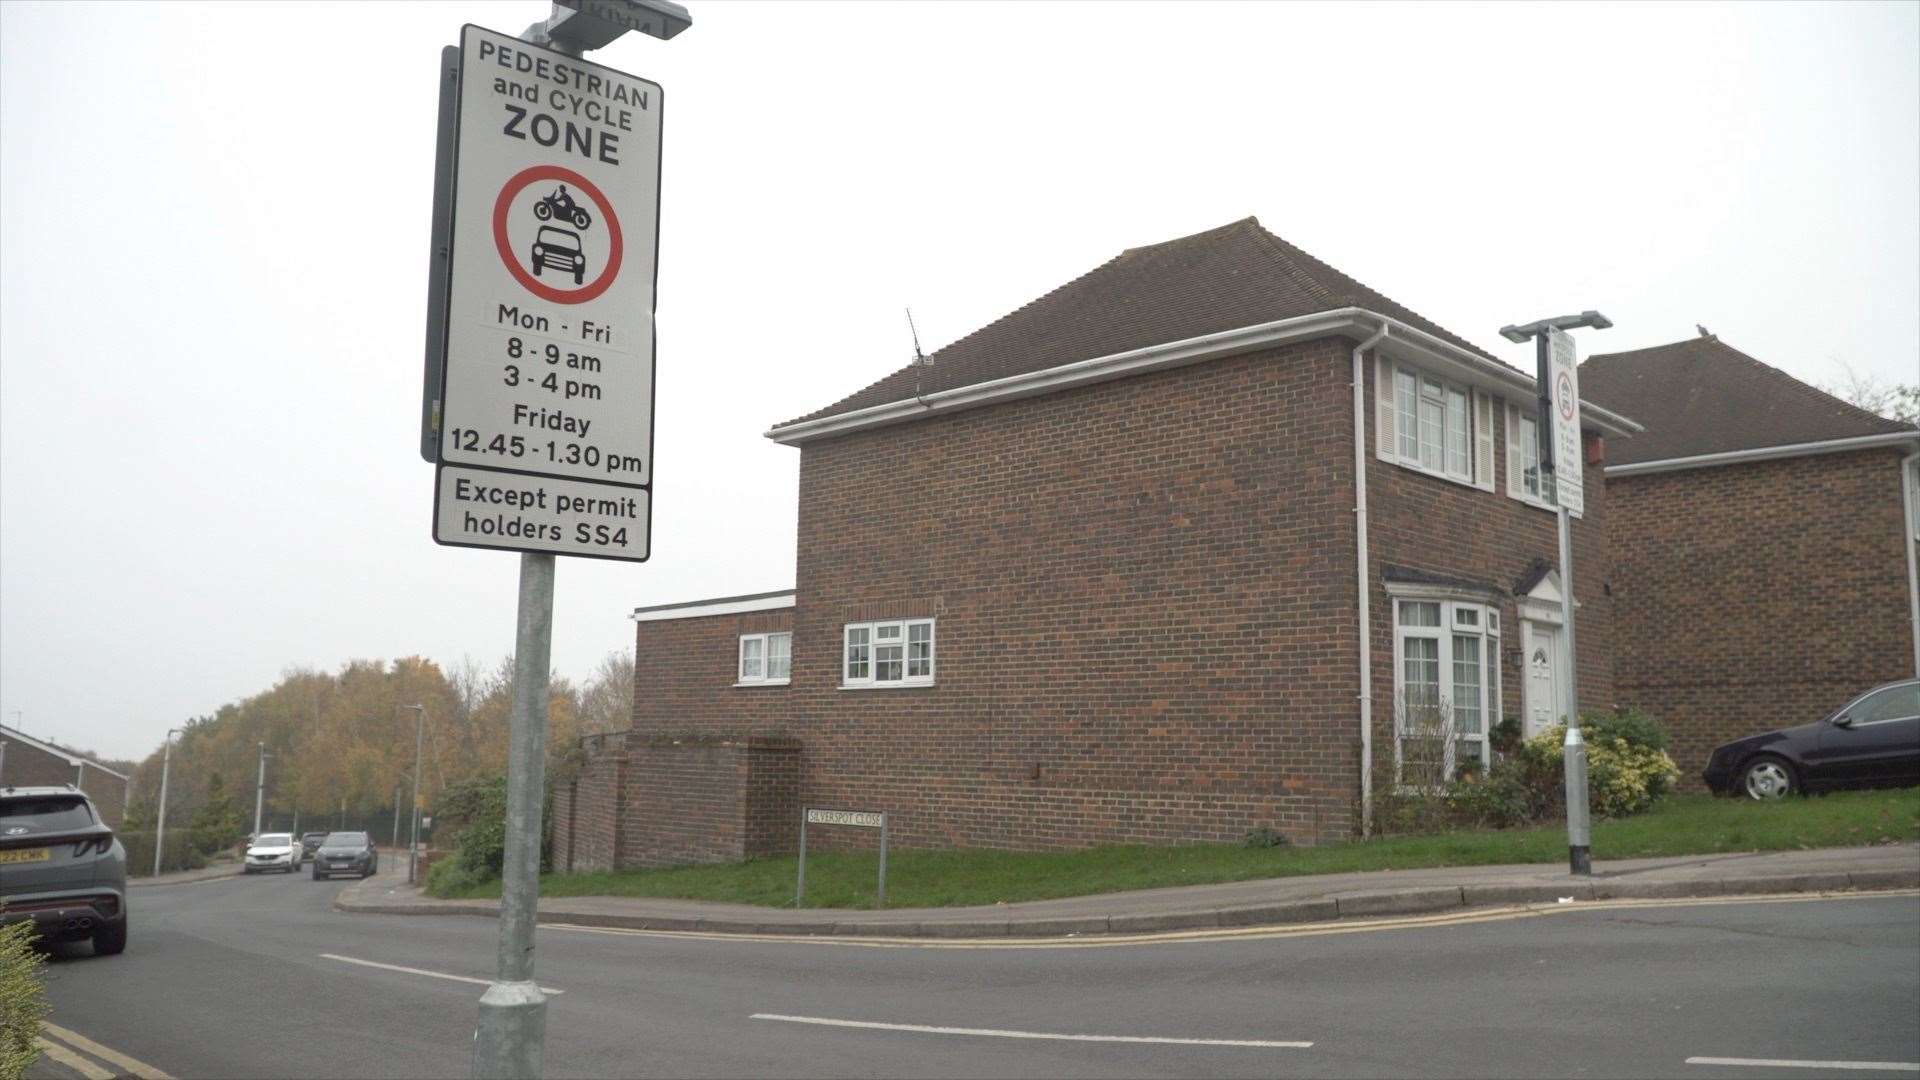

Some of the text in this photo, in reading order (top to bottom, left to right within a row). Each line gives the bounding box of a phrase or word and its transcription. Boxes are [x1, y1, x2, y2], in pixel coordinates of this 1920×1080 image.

[480, 40, 648, 110] PEDESTRIAN
[493, 77, 632, 131] and CYCLE
[503, 104, 619, 166] ZONE
[498, 303, 549, 332] Mon
[581, 320, 611, 344] Fri
[566, 352, 601, 373] am
[565, 380, 602, 401] pm
[513, 404, 590, 438] Friday
[606, 454, 642, 474] pm
[456, 478, 637, 519] Except permit
[464, 511, 629, 548] holders SS4
[809, 810, 853, 824] SILVERSPOT
